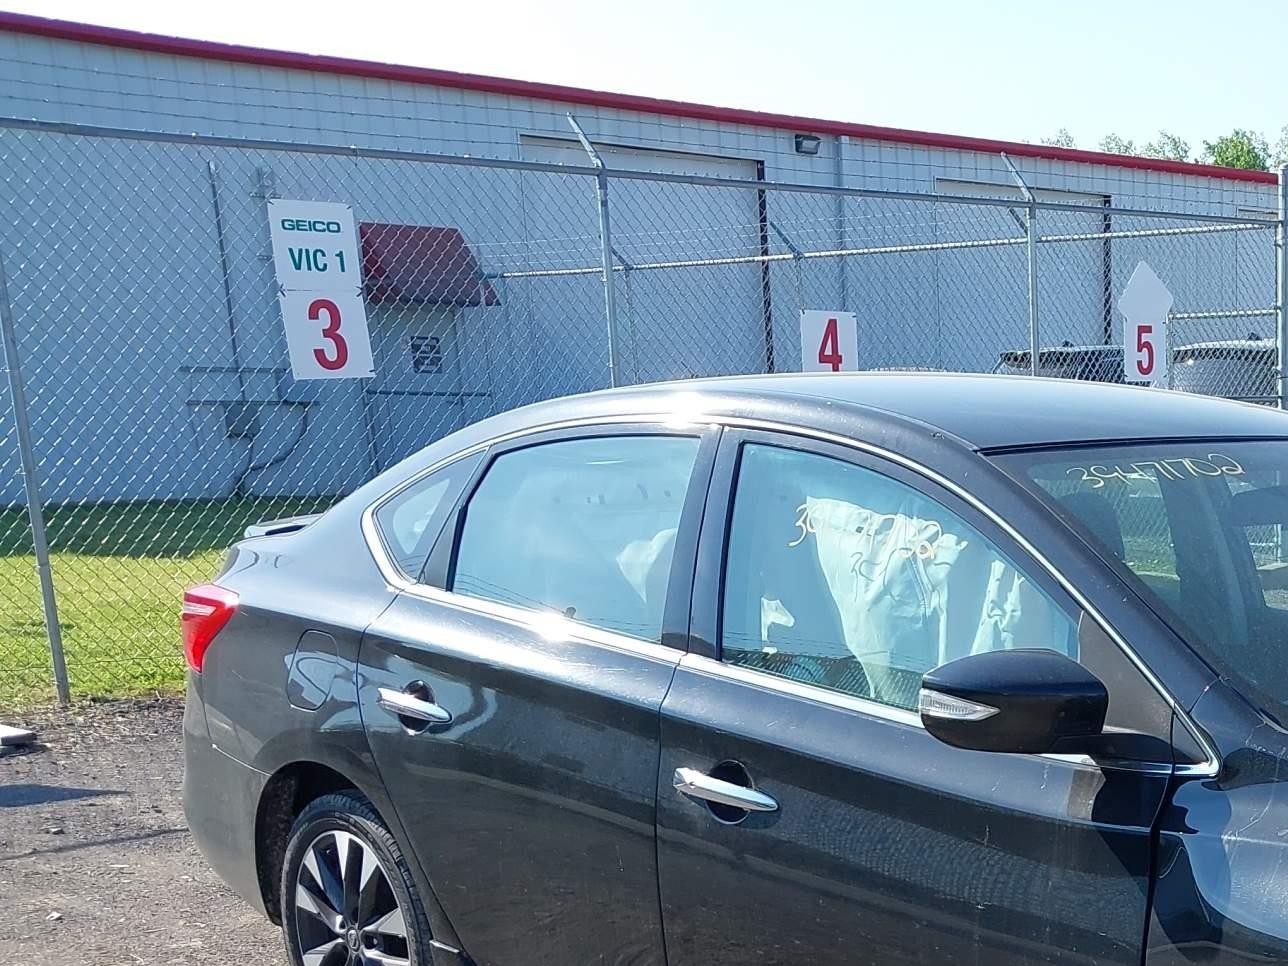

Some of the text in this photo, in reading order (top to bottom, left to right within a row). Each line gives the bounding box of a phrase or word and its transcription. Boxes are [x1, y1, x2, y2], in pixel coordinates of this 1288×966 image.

[281, 219, 341, 233] GEICO
[288, 247, 346, 273] VIC 1
[308, 298, 348, 371] 3
[818, 318, 842, 372] 4
[1136, 325, 1153, 376] 5
[1066, 453, 1246, 489] 39471702
